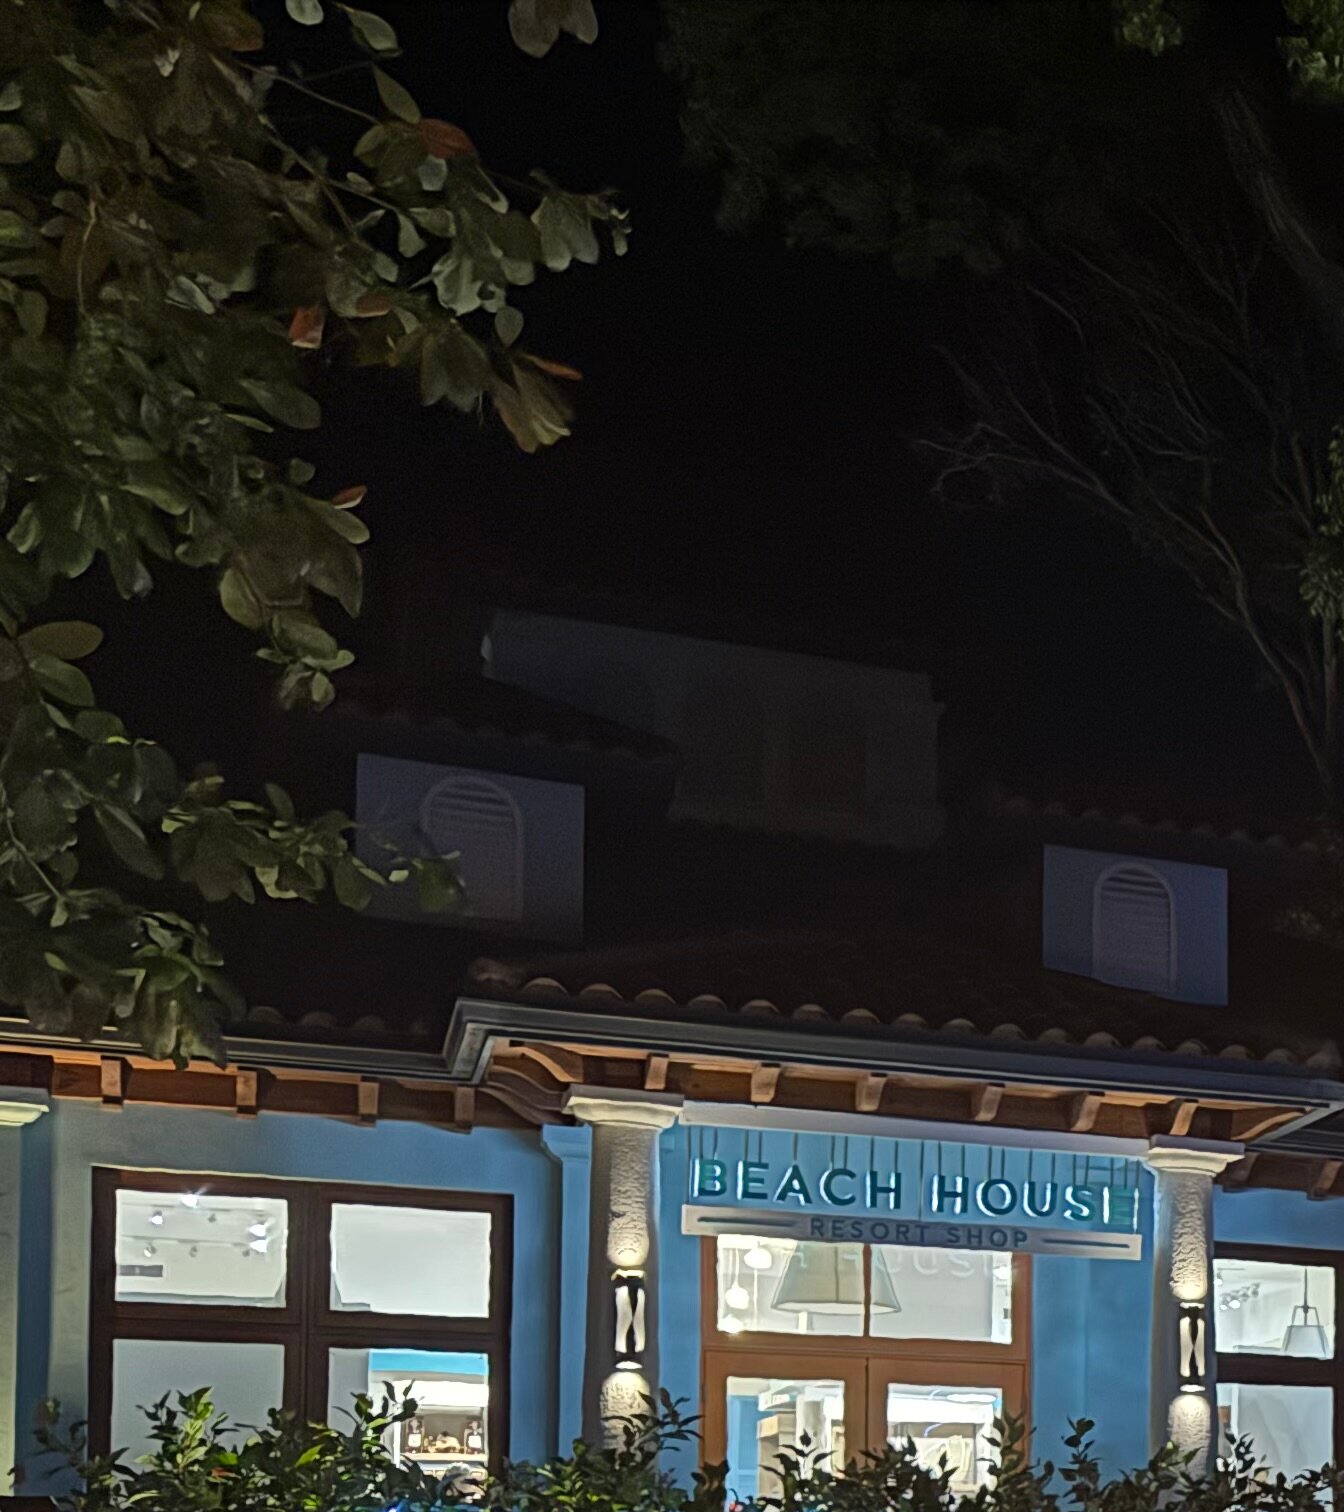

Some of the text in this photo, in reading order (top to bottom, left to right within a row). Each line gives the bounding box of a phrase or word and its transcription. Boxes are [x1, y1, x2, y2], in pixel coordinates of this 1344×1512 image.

[692, 1157, 902, 1209] BEACH
[809, 1218, 1029, 1248] RESORT SHOP
